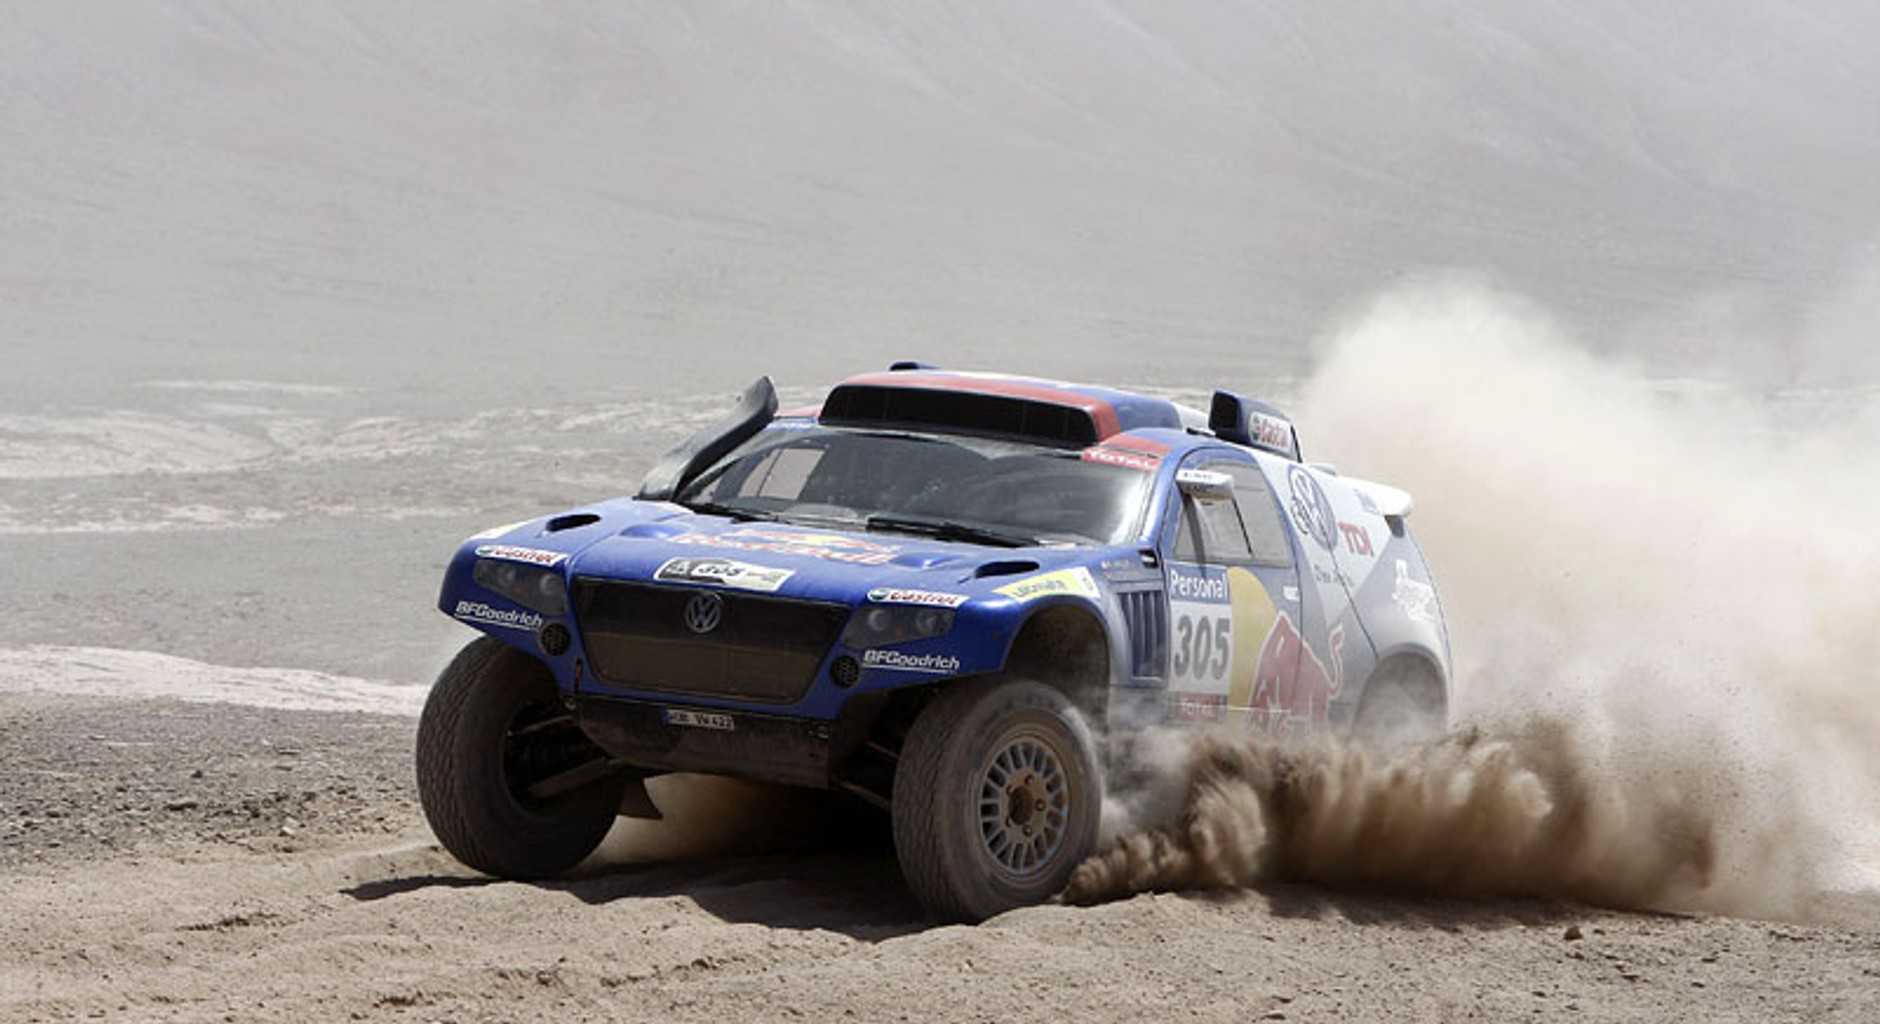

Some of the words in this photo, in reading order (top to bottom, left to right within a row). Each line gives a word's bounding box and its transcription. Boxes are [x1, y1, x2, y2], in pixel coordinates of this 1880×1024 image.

[1091, 450, 1150, 467] TOTAL
[1338, 521, 1375, 557] TDI
[1170, 568, 1228, 599] Personal
[890, 591, 959, 605] Castrol
[456, 601, 543, 627] BFGoodrich
[864, 649, 961, 670] BFGoodrich
[1173, 614, 1231, 681] 305
